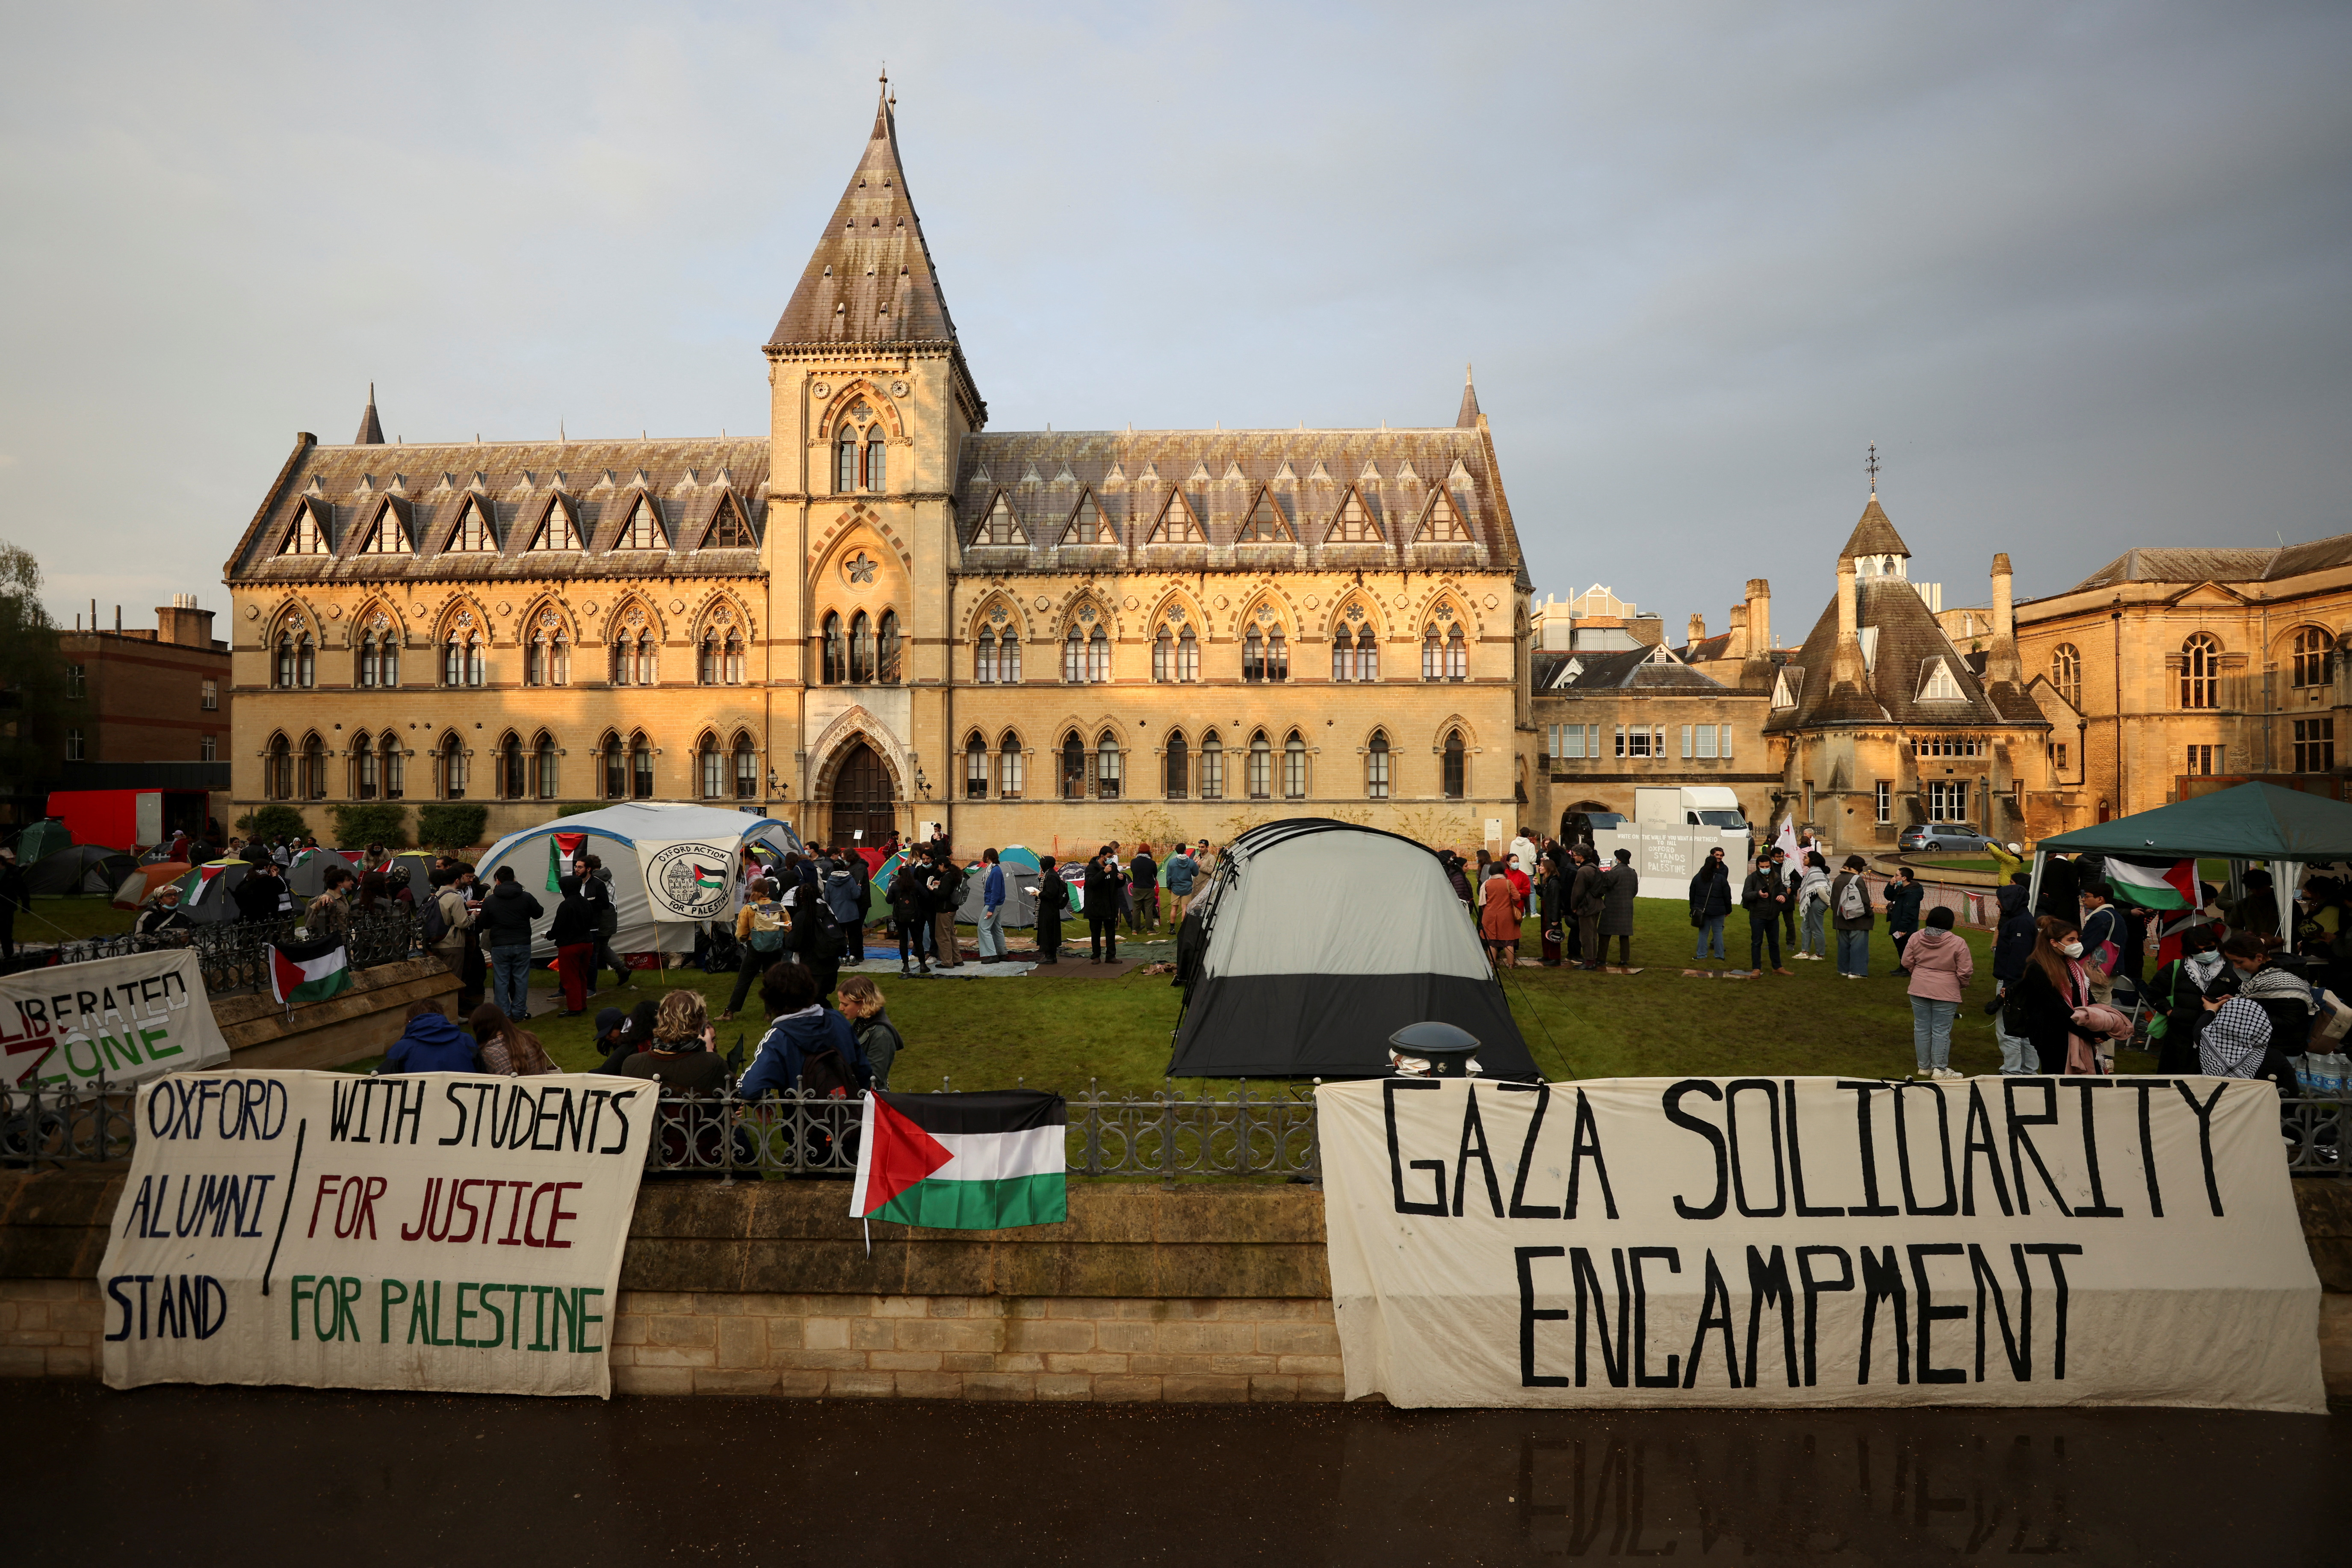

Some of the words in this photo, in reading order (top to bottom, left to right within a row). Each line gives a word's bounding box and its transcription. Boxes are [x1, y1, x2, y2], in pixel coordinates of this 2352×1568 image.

[659, 846, 691, 862] OXFORD
[694, 846, 726, 859] ACTION
[1648, 862, 1686, 875] PALESTINE
[1654, 852, 1685, 862] STANDS
[669, 901, 684, 912] FOR
[691, 890, 729, 914] PALESTINE
[627, 956, 648, 966] wilko
[5, 1014, 184, 1090] ZONE
[148, 1079, 287, 1140] OXFORD
[330, 1080, 426, 1145] WITH
[438, 1082, 637, 1155] STUDENTS
[1383, 1079, 1619, 1220] GAZA
[1662, 1077, 2230, 1220] SOLIDARITY
[123, 1174, 275, 1238] ALUMNI
[307, 1174, 387, 1240] FOR
[401, 1177, 583, 1248] JUSTICE
[105, 1275, 227, 1341] STAND
[291, 1275, 361, 1342] FOR
[381, 1279, 604, 1353] PALESTINE
[1514, 1243, 2083, 1389] ENCAMPMENT
